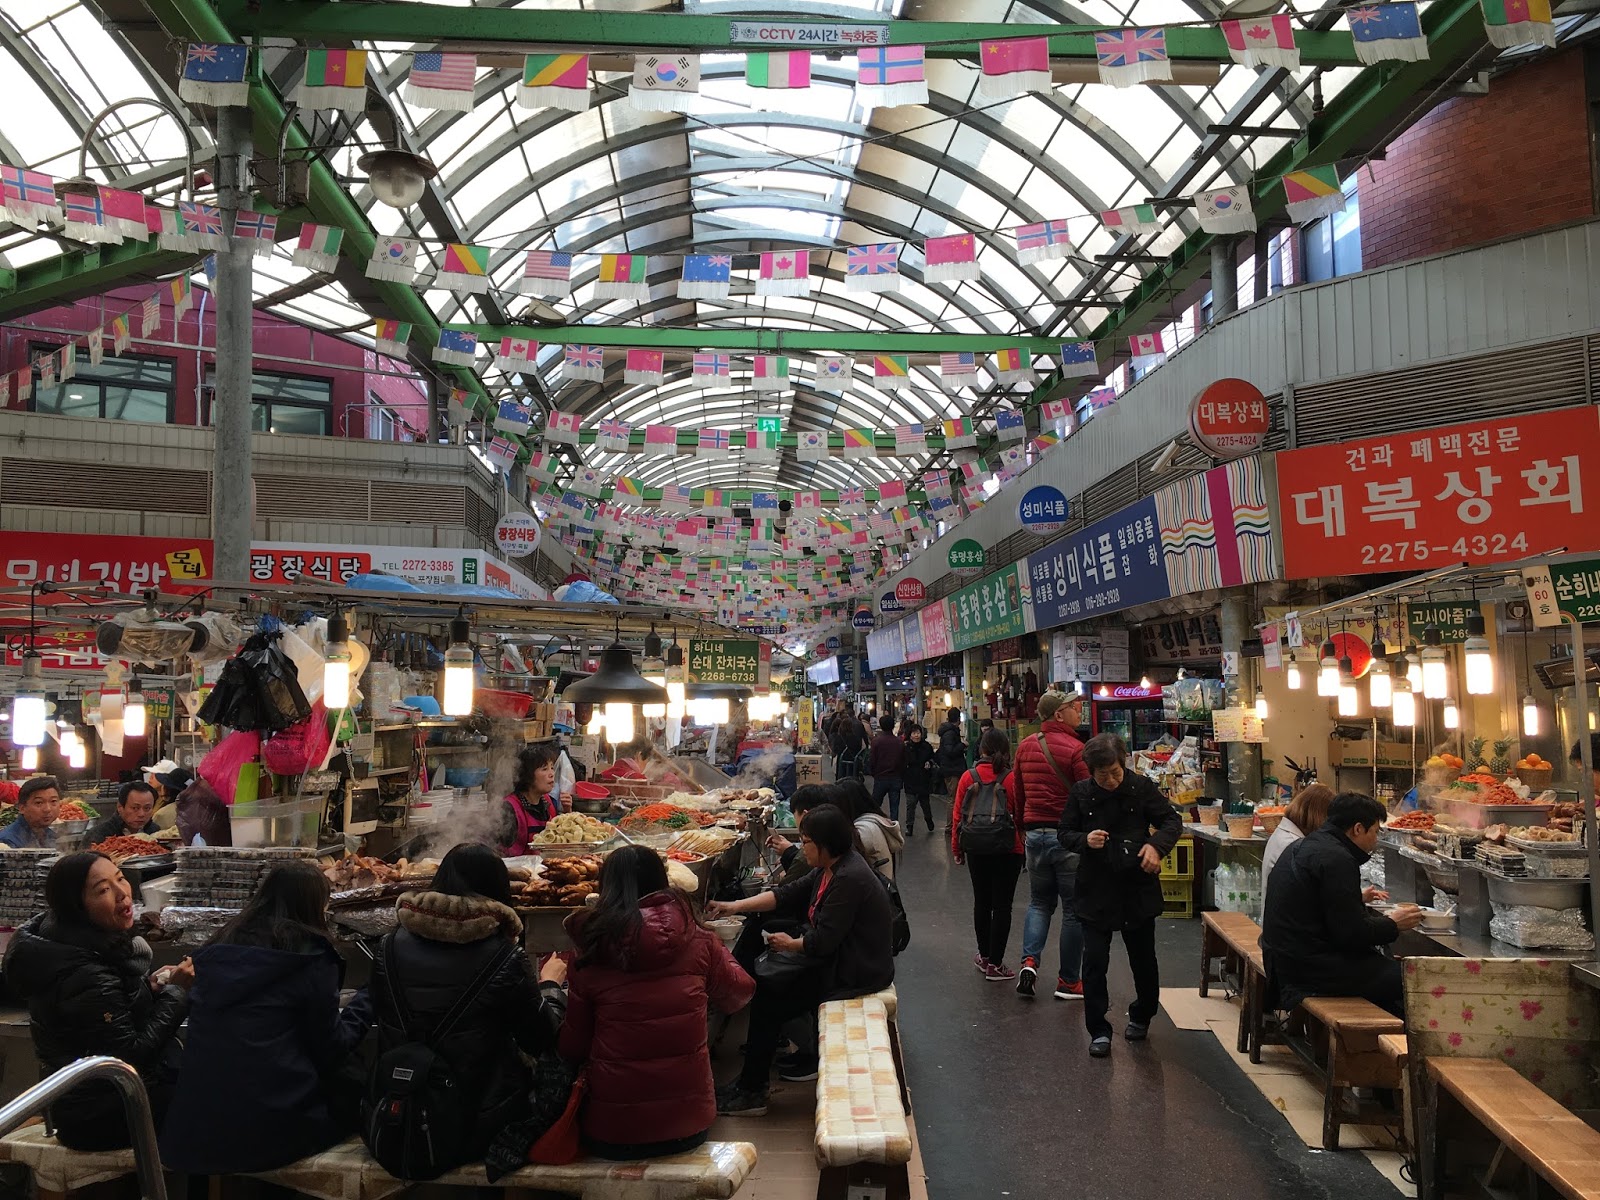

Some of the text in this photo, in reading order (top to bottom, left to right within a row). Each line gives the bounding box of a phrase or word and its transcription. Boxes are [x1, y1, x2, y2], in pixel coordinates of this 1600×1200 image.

[759, 28, 878, 43] CCTV 24시간 녹화중
[1200, 400, 1265, 425] 대복상회
[1216, 435, 1257, 447] 2275-4324
[1345, 425, 1523, 473] 건과 폐백전문
[1290, 454, 1585, 538] 대복상회
[1022, 500, 1065, 518] 성미식품
[498, 527, 536, 542] 광장식당
[1117, 515, 1154, 550] 일회용품
[1360, 531, 1529, 565] 2275-4324
[950, 550, 983, 563] 동명홍삼
[251, 554, 362, 581] 광장식당
[382, 559, 454, 571] TEL 2272-3385
[1053, 532, 1117, 597] 성미식품
[464, 562, 475, 583] 단체
[898, 583, 923, 597] 신안상회
[1534, 589, 1548, 600] 60
[881, 599, 904, 609] 일심상
[960, 576, 1007, 630] 동명홍삼
[1540, 603, 1552, 615] 호
[1393, 620, 1405, 629] 62
[693, 643, 724, 654] 하니네
[692, 655, 757, 671] 순대 잔치국수
[701, 672, 755, 682] 2268-6738
[1114, 685, 1150, 697] Coca-Cola
